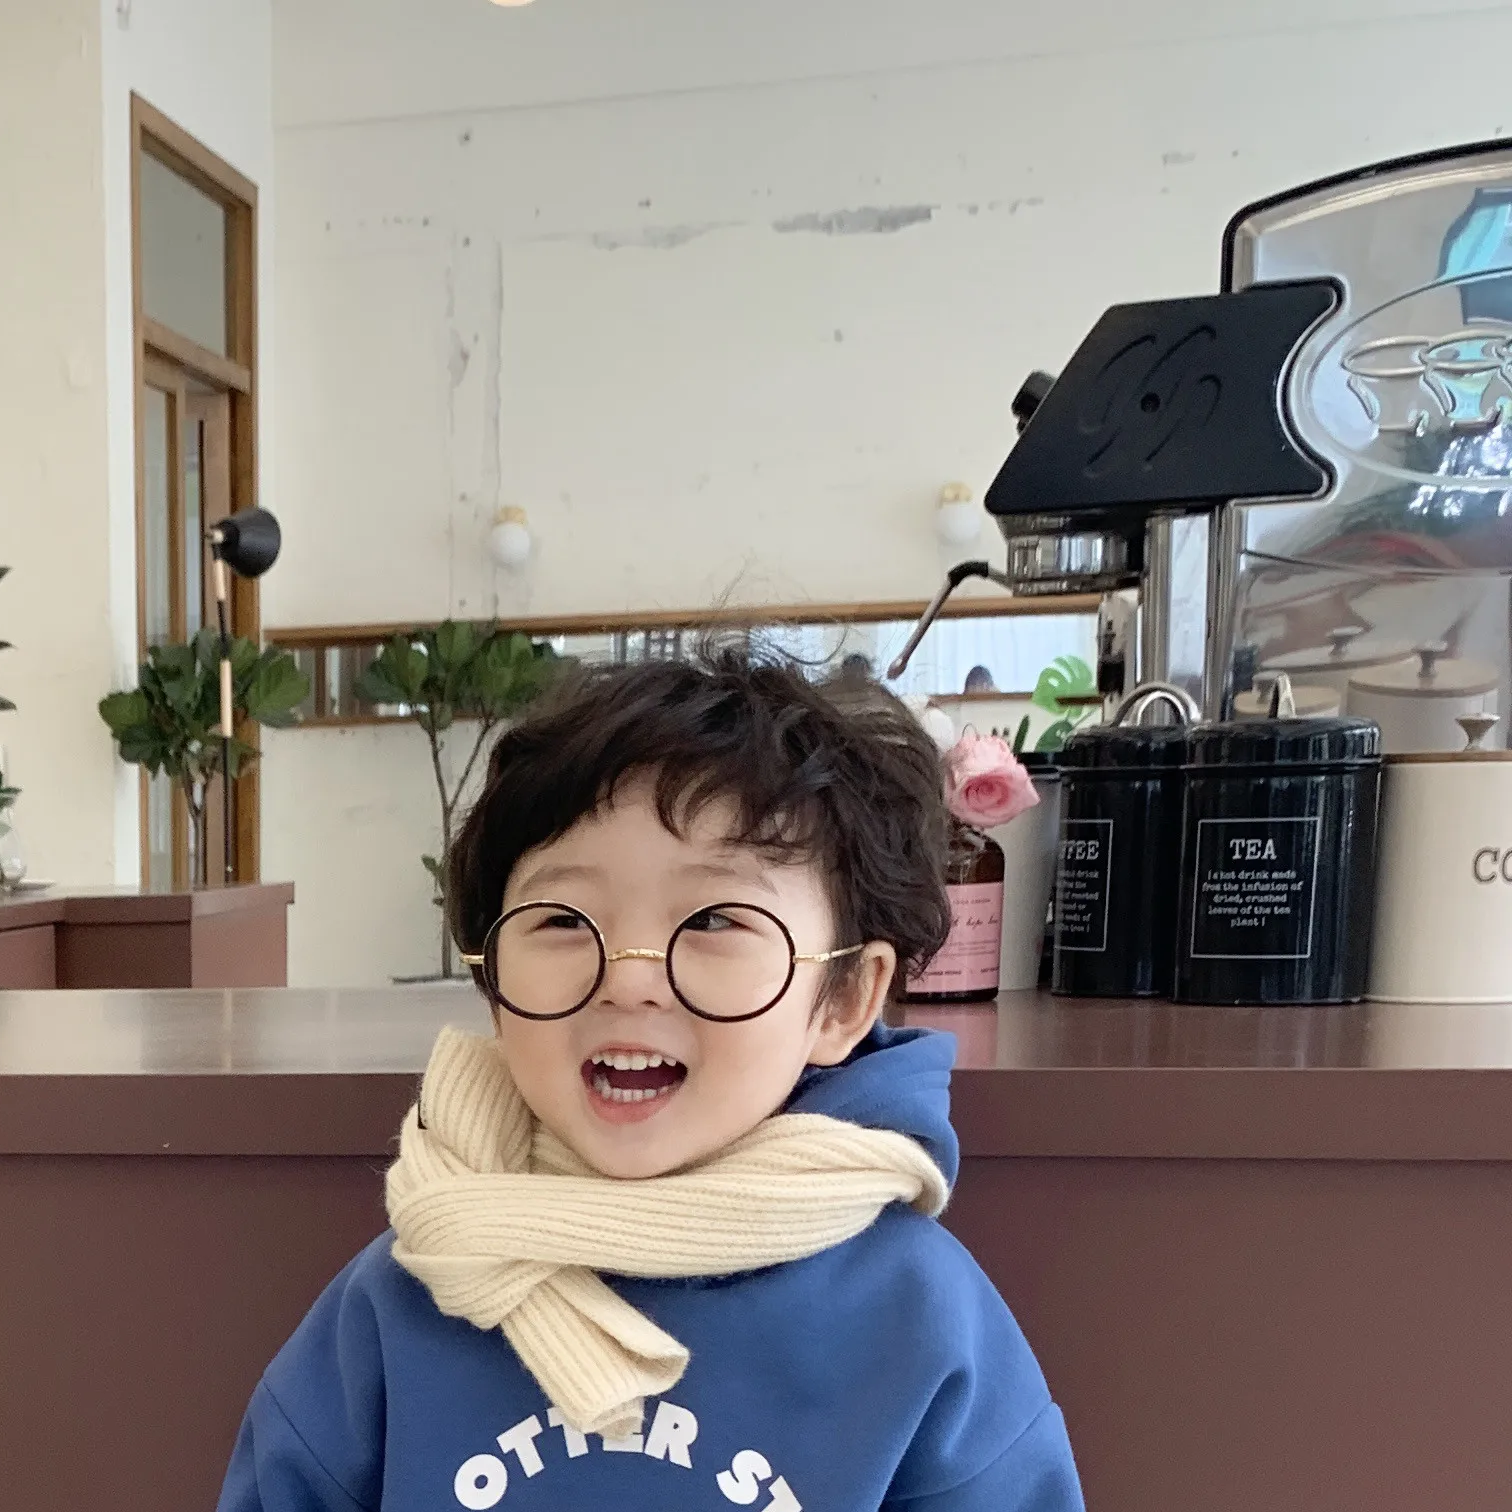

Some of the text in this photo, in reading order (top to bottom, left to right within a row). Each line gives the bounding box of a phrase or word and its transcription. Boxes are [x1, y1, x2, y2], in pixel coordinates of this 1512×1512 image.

[1229, 838, 1277, 860] TEA
[1238, 870, 1269, 880] drink
[1202, 880, 1304, 893] from the infusion of
[1245, 893, 1288, 903] crushed
[1240, 904, 1252, 915] of
[1254, 905, 1271, 915] the
[1230, 917, 1259, 928] plant
